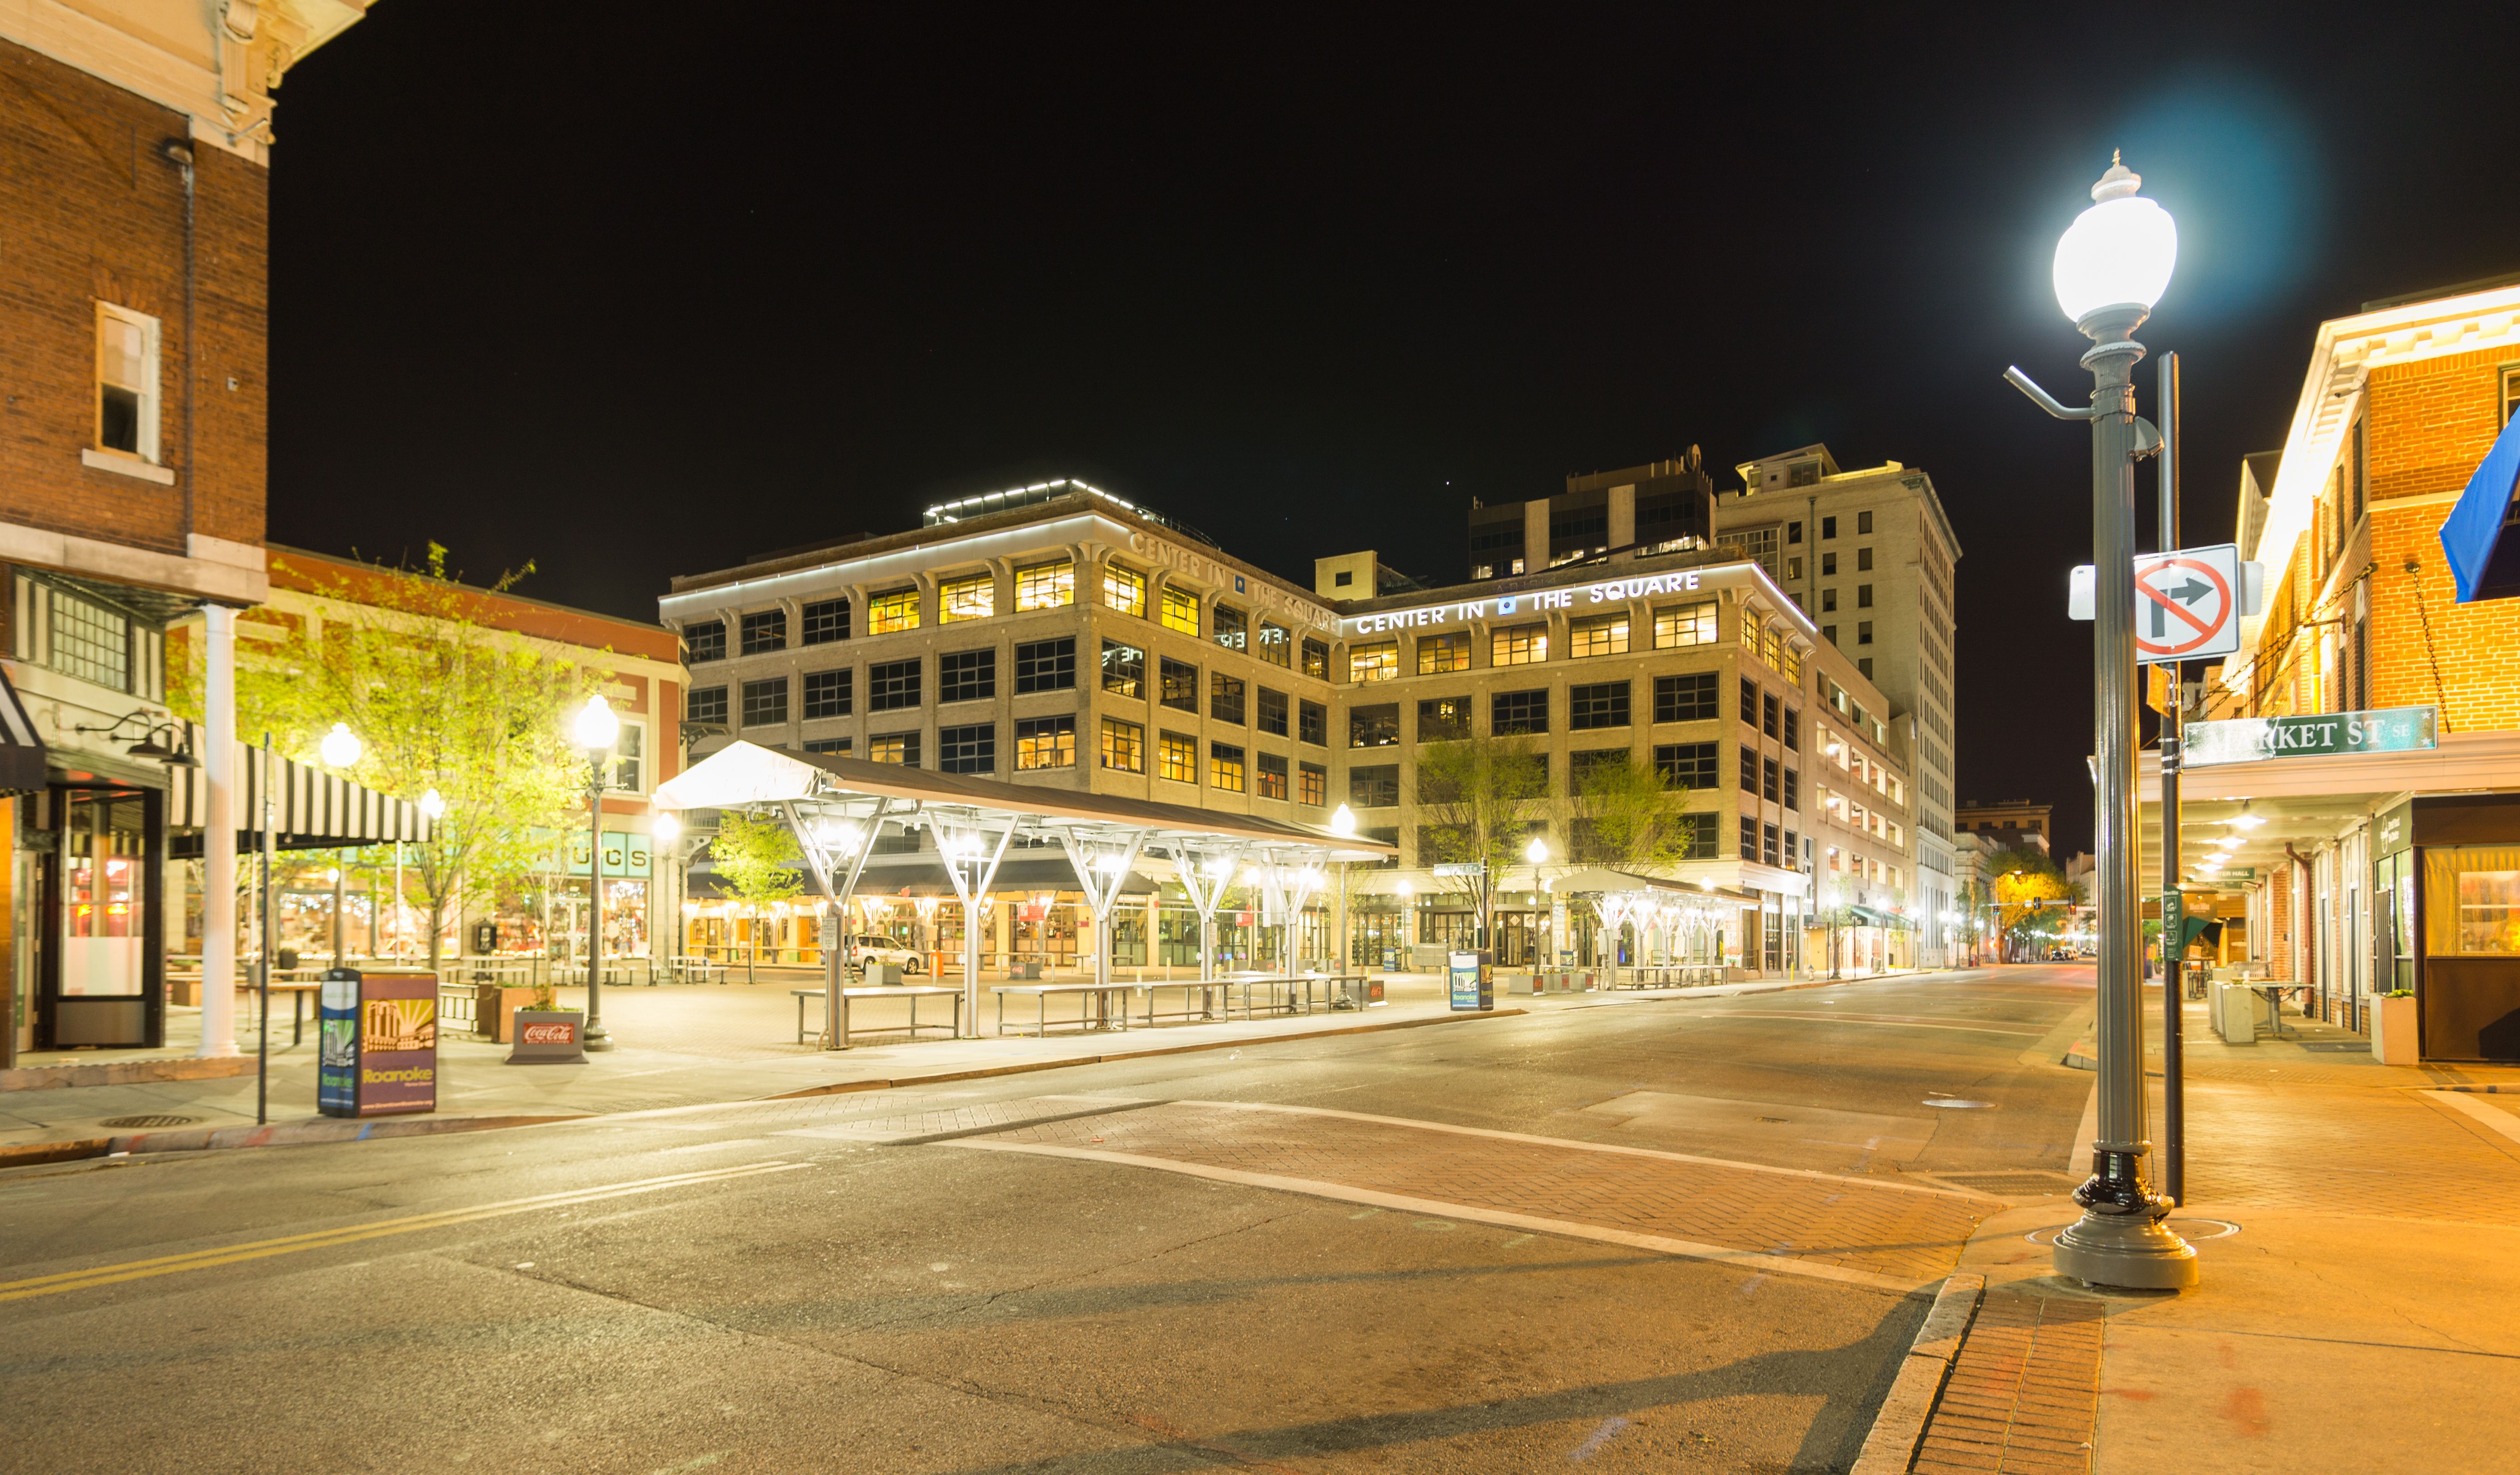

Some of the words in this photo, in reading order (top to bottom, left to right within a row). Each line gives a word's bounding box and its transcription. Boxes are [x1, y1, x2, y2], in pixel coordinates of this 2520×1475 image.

[1130, 532, 1200, 578] CENTER
[1207, 563, 1225, 588] IN
[1253, 582, 1277, 609] THE
[1284, 596, 1336, 632] SQUARE
[1357, 607, 1446, 634] CENTER
[1458, 601, 1484, 620] IN
[1532, 589, 1573, 610] THE
[1590, 570, 1699, 604] SQUARE
[2347, 719, 2386, 745] ST
[2392, 723, 2410, 738] SE
[525, 1026, 572, 1040] Coca-Cola
[362, 1066, 433, 1084] Roanoke
